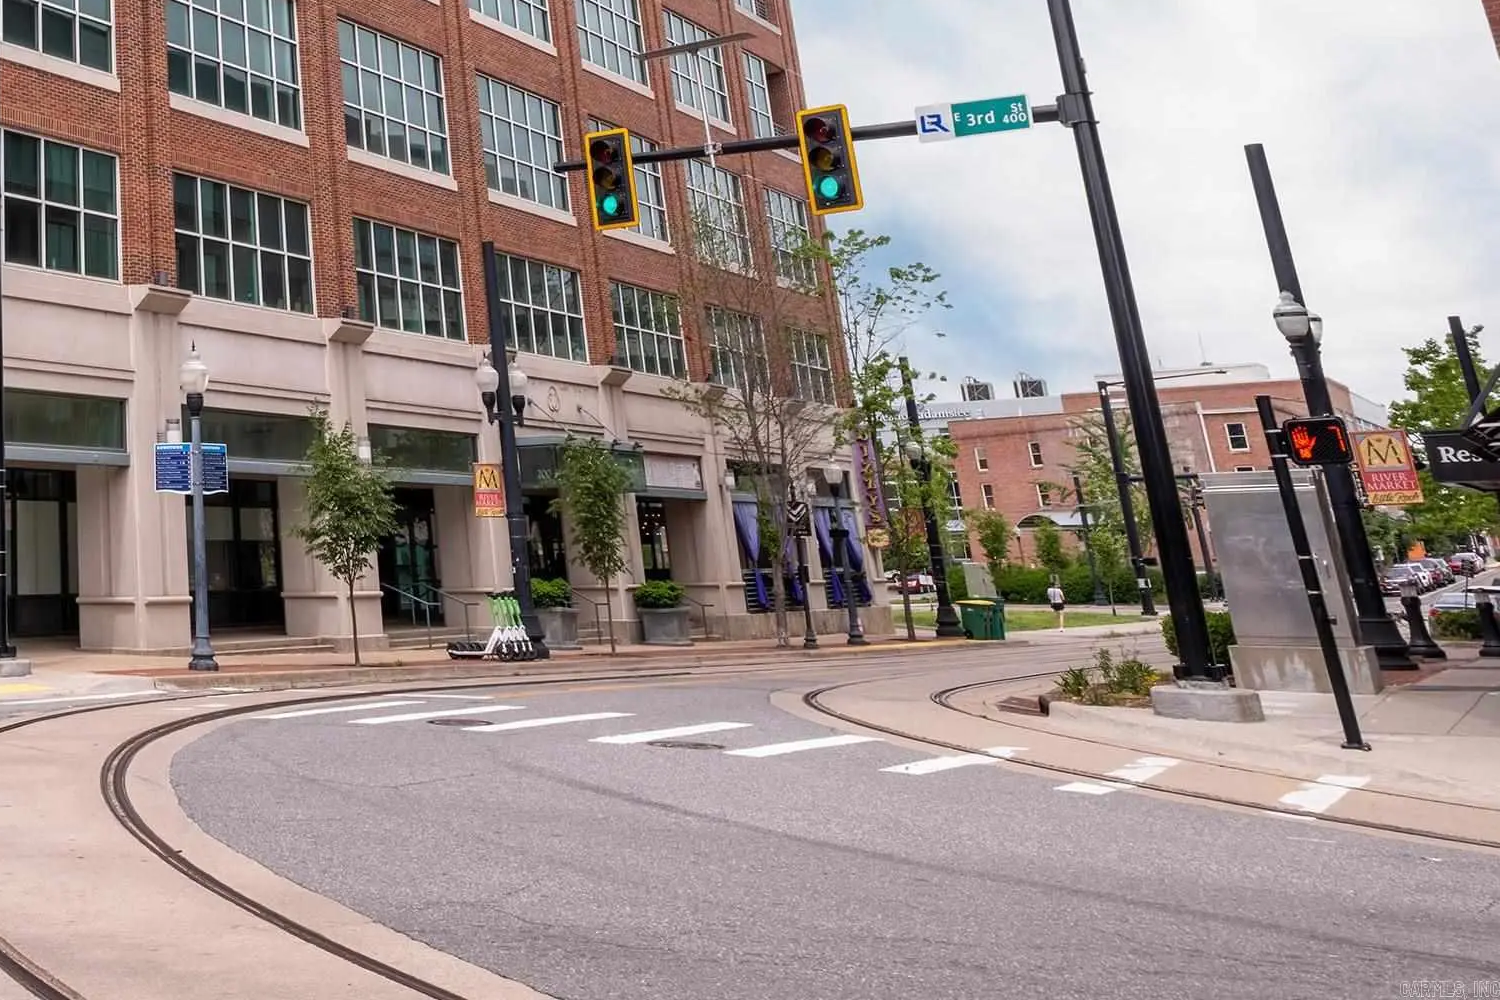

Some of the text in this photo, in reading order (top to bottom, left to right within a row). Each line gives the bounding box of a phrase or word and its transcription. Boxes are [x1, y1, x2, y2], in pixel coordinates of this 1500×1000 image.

[1010, 102, 1023, 113] St
[954, 110, 995, 126] E 3rd
[1002, 112, 1027, 124] 400
[1371, 472, 1408, 482] RIVER
[1367, 480, 1416, 491] MARKET
